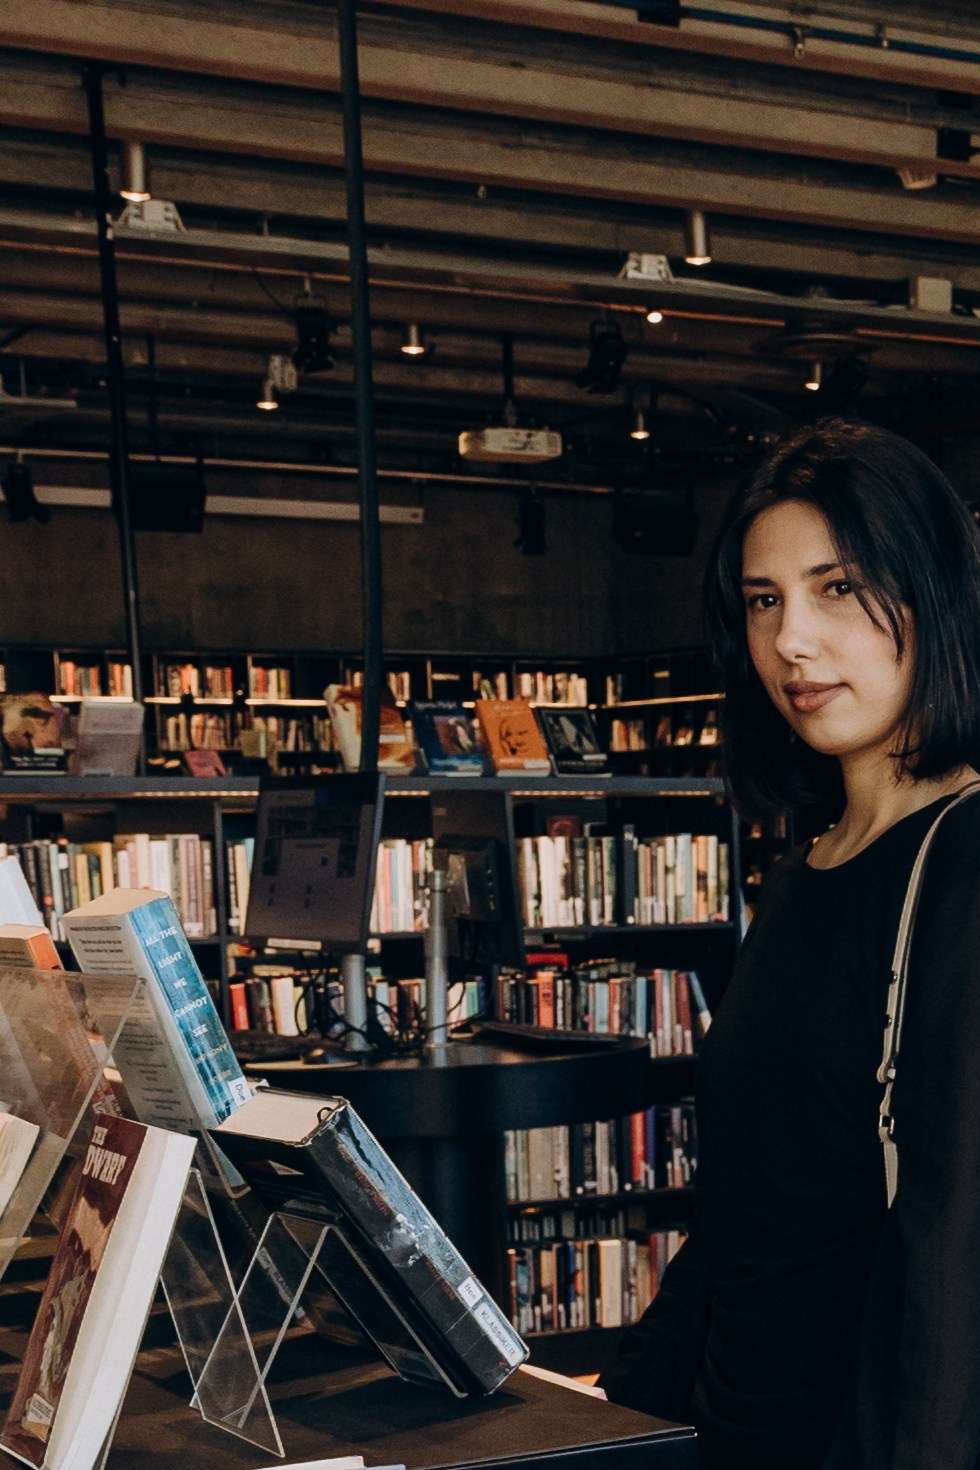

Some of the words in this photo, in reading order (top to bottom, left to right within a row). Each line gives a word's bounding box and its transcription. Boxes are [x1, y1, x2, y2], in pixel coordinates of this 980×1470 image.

[145, 934, 159, 946] ALL
[159, 926, 178, 939] THE
[158, 951, 183, 969] LIGHT
[173, 977, 188, 989] WE
[174, 996, 208, 1018] CANNOT
[192, 1023, 209, 1038] SEE
[82, 1144, 128, 1186] DWARF
[480, 1309, 516, 1357] KLASSIKER
